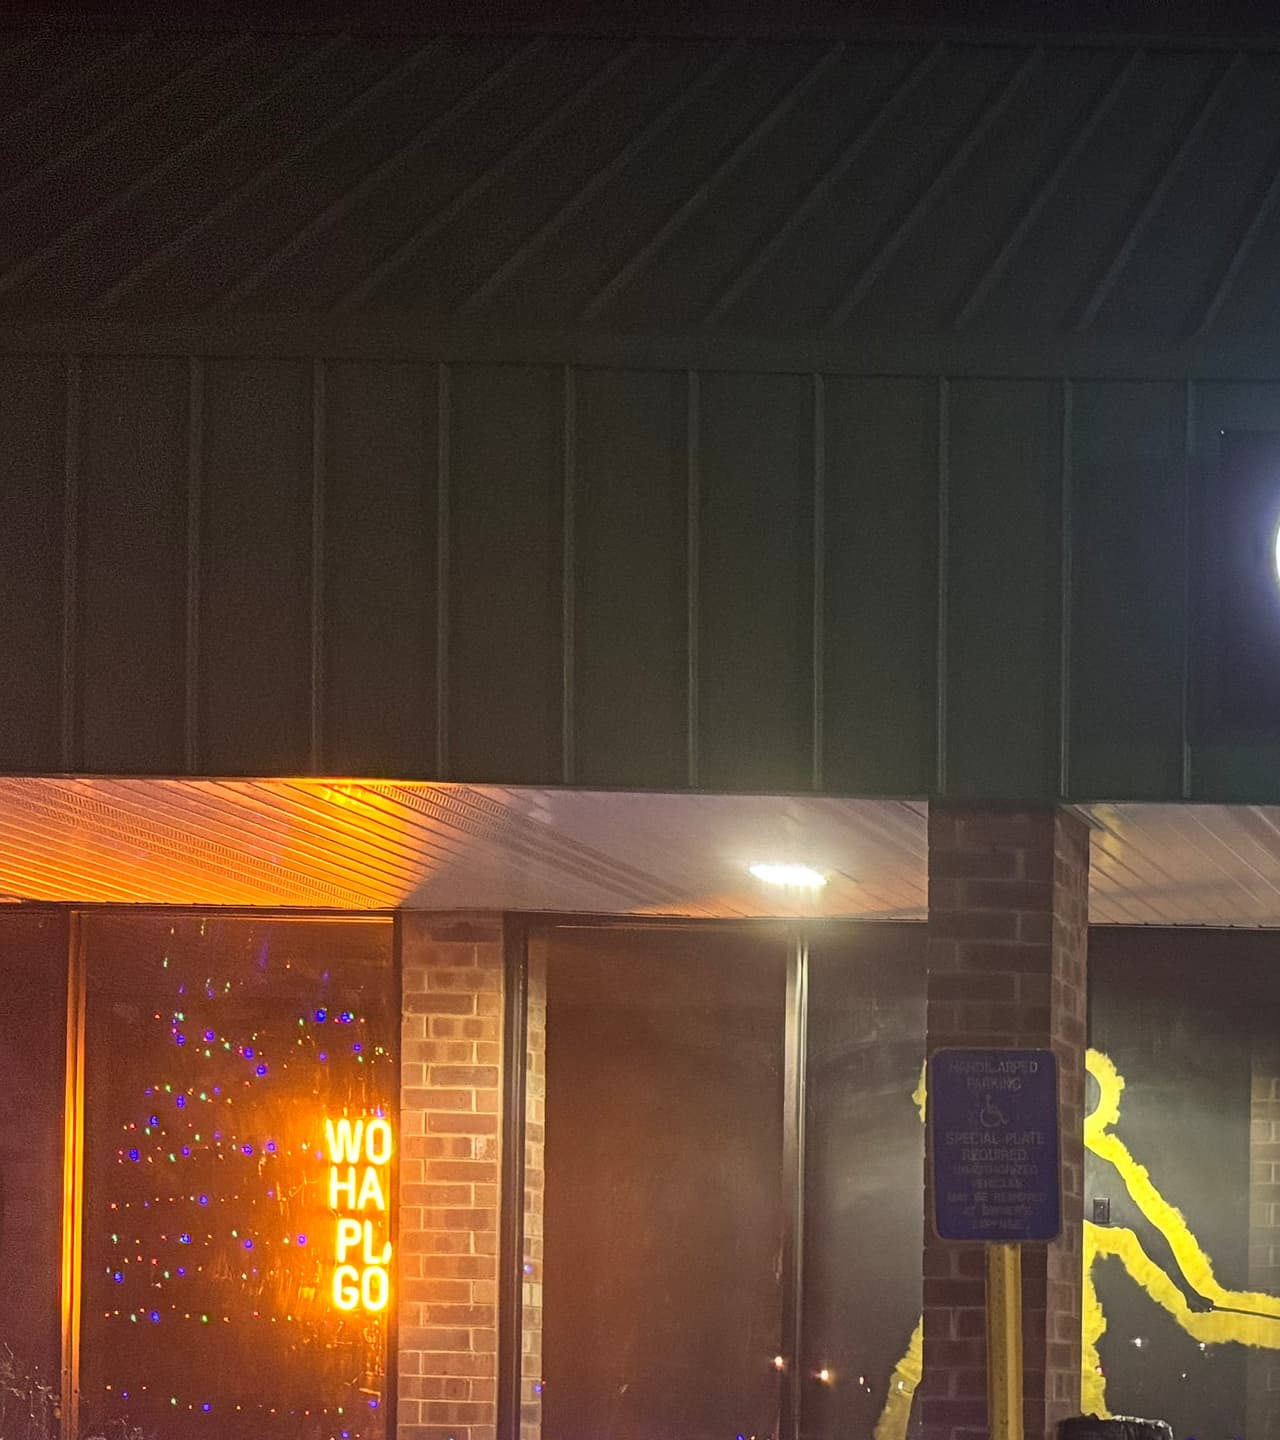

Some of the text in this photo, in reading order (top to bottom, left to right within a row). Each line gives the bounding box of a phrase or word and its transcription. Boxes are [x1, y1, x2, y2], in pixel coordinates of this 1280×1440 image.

[325, 1118, 392, 1165] WO
[329, 1166, 385, 1210] HA
[337, 1218, 392, 1265] PL
[332, 1265, 389, 1311] GO
